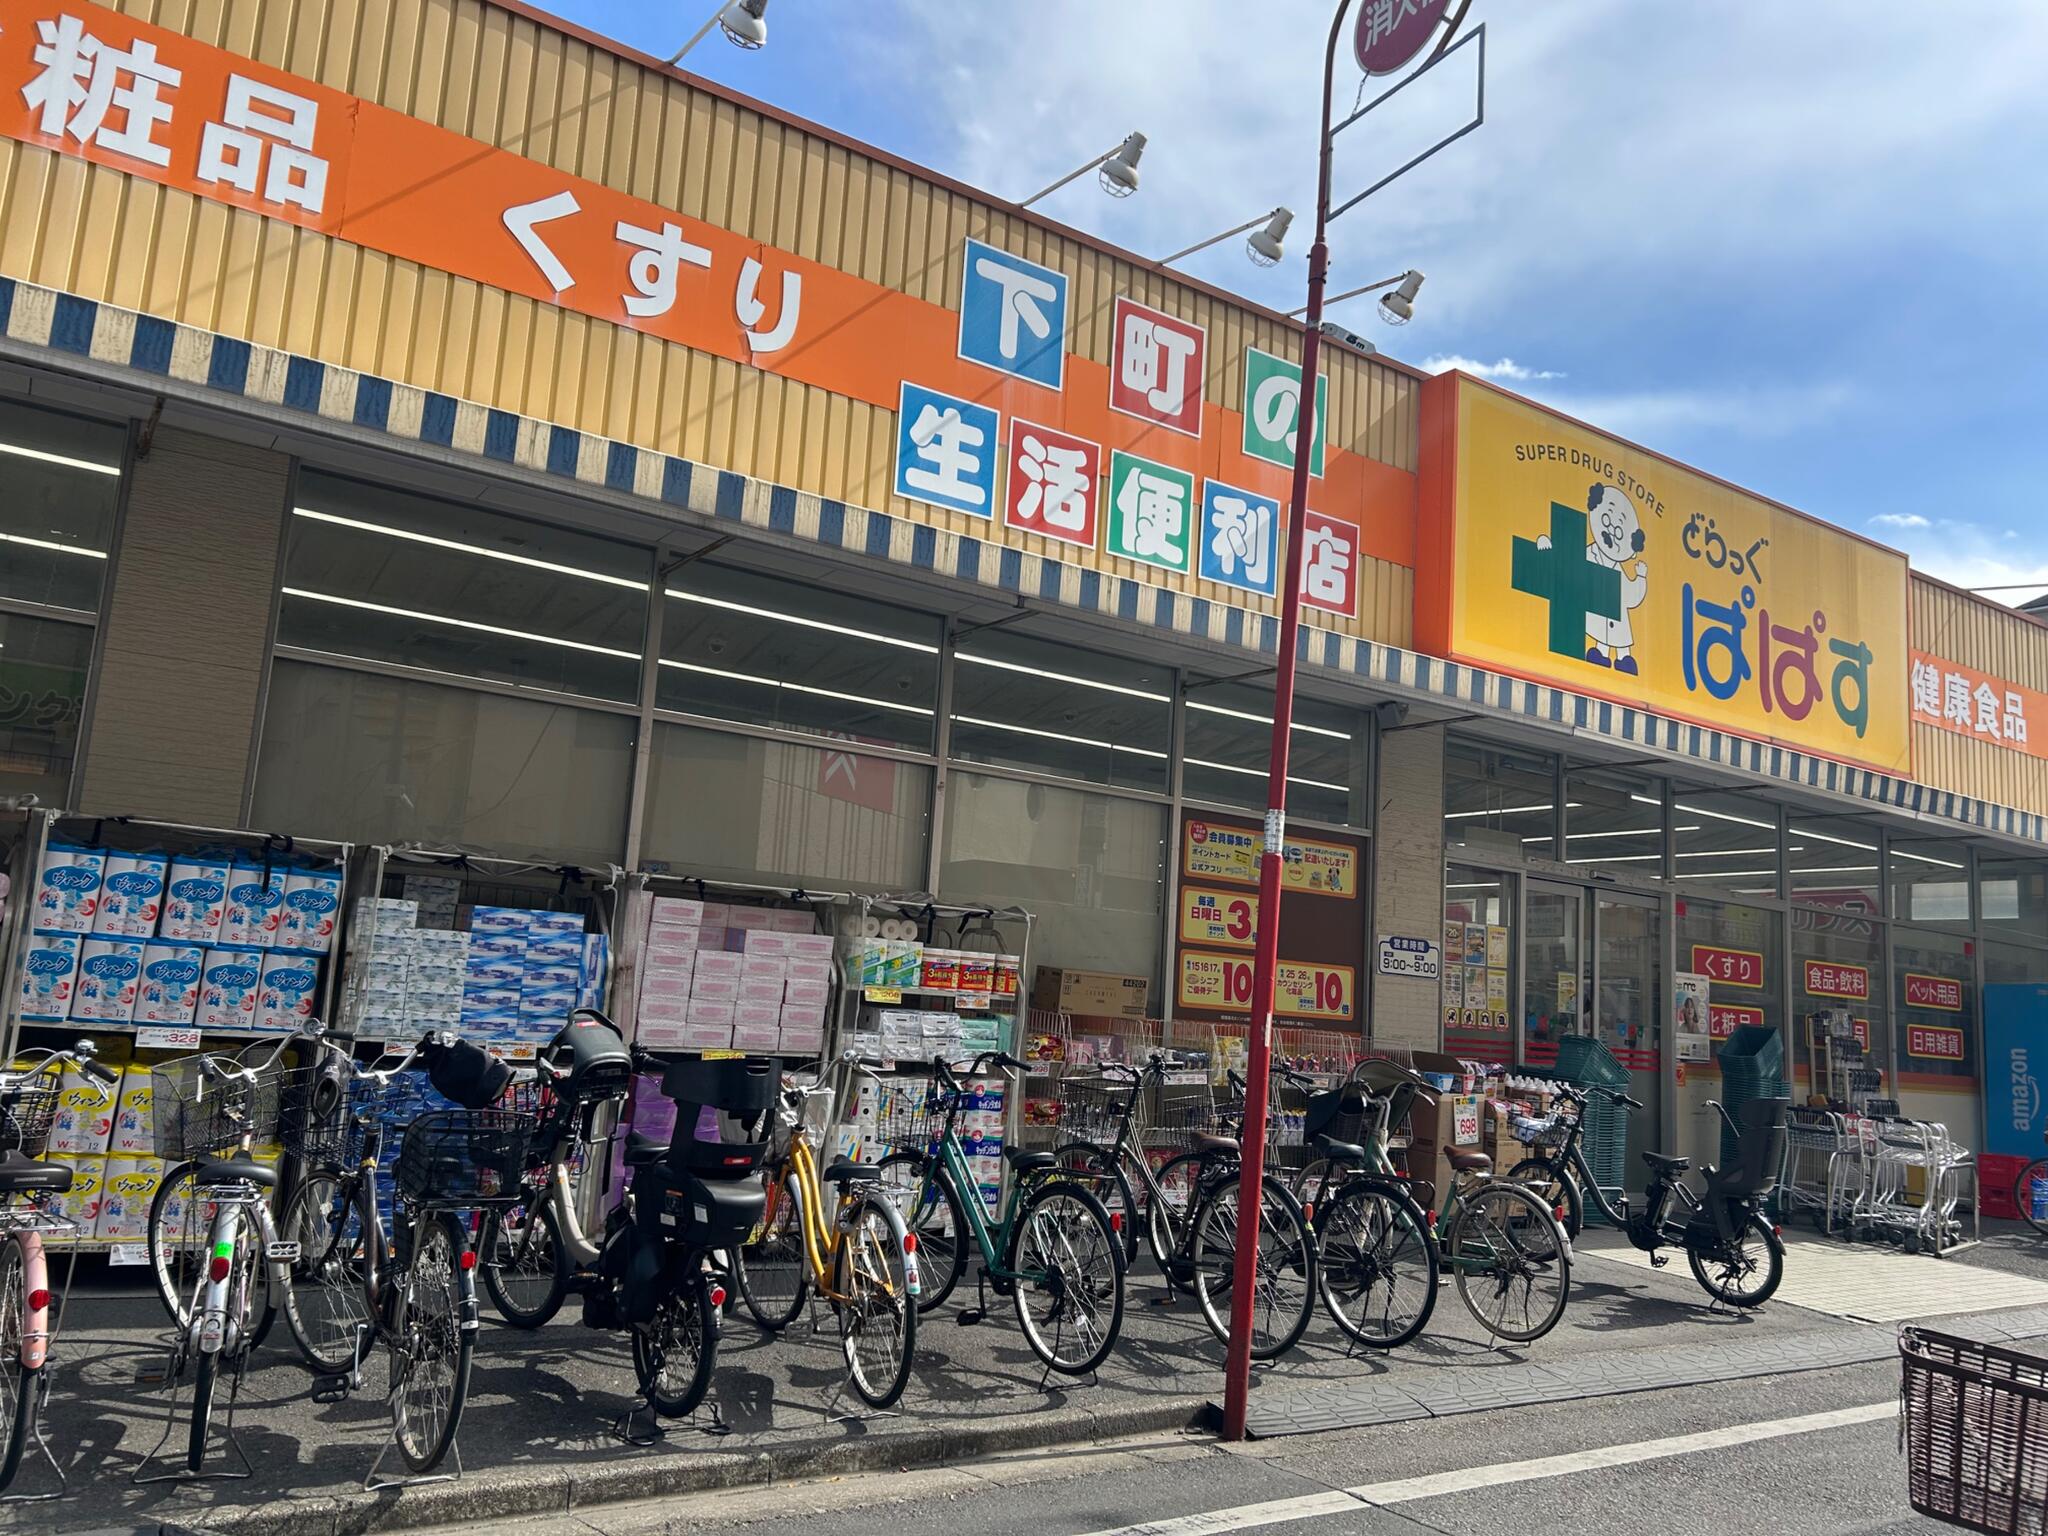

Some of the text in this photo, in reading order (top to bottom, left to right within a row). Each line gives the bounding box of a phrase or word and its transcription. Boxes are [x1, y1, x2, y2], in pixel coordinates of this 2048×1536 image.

[1365, 0, 1436, 52] 消火
[0, 13, 802, 353] 粧品 くすり
[975, 256, 1320, 456] 下町の
[904, 402, 1350, 605] 生活便利店
[1515, 444, 1665, 519] SUPER DRUG STORE
[1682, 512, 1769, 584] どらっぐ
[1682, 582, 1874, 740] ぱぱす
[1911, 658, 2029, 745] 健康食品
[1191, 900, 1251, 939] 日曜日 3
[1223, 961, 1253, 1003] 10
[1705, 954, 1751, 980] くすり
[1809, 967, 1865, 996] 食品・飲料
[1315, 971, 1343, 1011] 10
[1909, 982, 1959, 1005] ペット用品
[169, 1033, 199, 1043] 328
[2011, 1048, 2031, 1132] amazon
[1460, 1118, 1477, 1135] 698
[143, 1248, 173, 1259] 38
